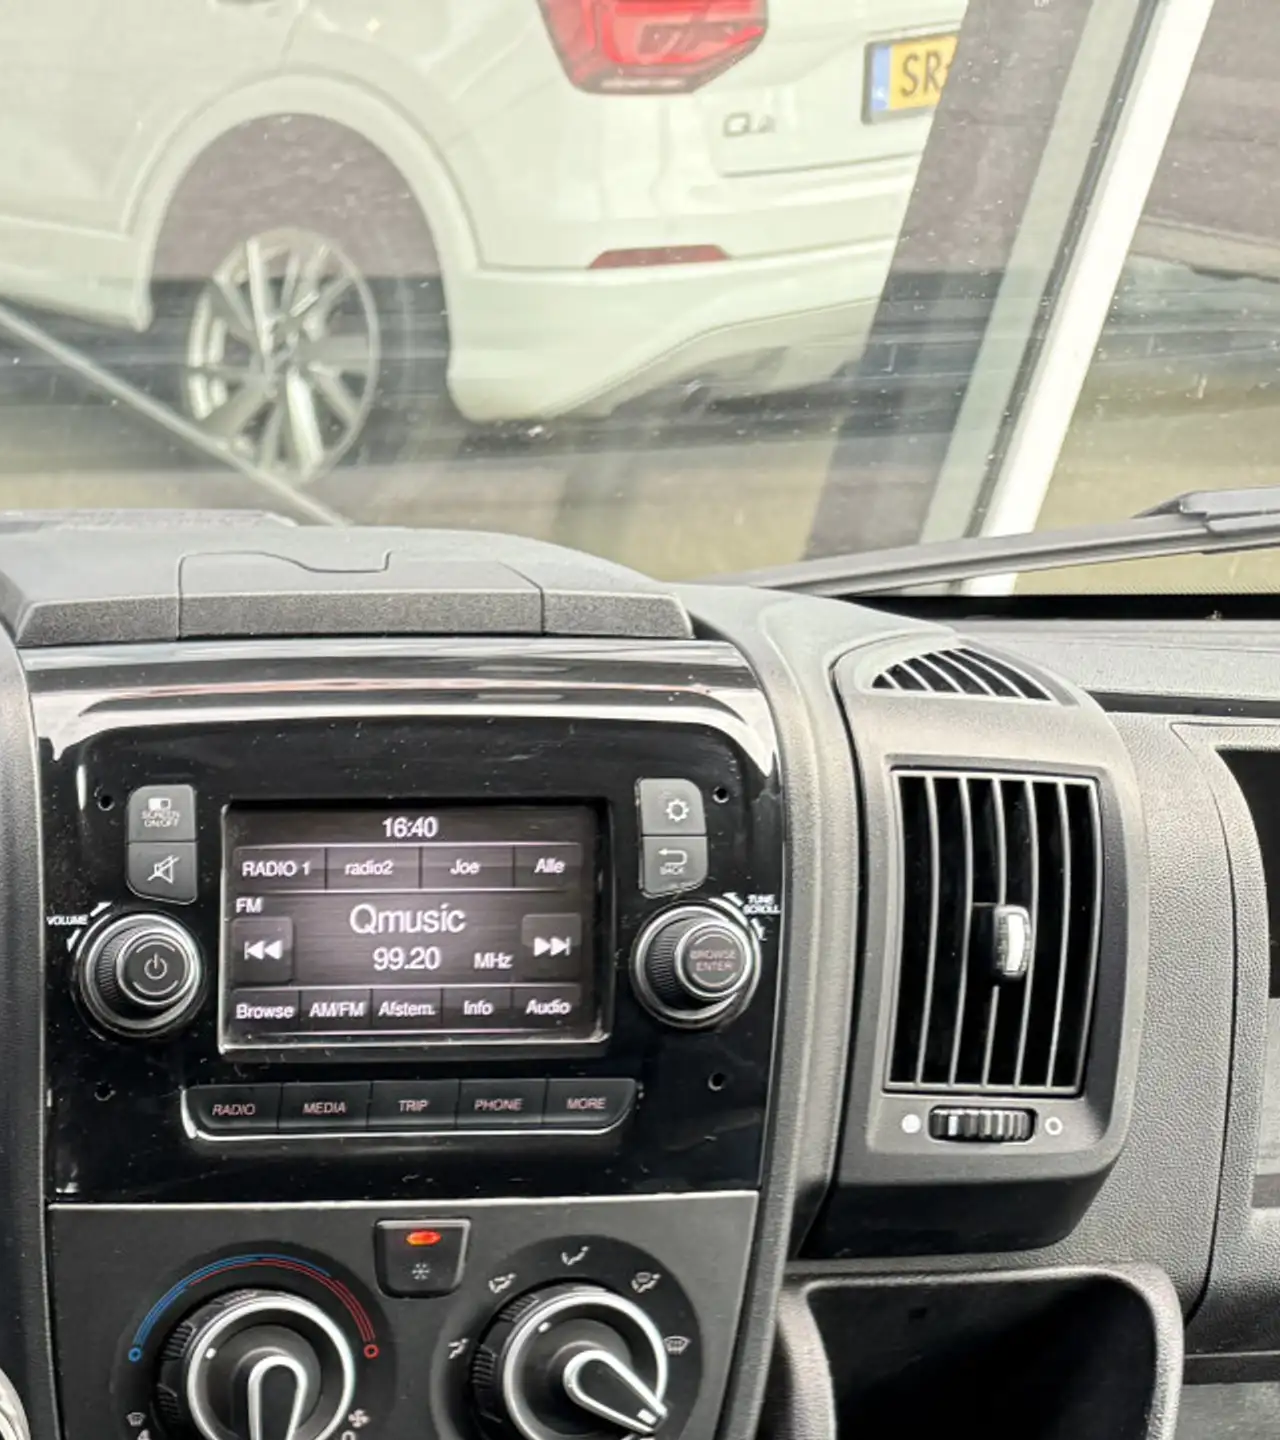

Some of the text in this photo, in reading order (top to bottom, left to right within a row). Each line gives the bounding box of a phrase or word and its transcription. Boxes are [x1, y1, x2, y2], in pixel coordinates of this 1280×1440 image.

[382, 816, 439, 838] 16:40
[242, 861, 311, 877] RADIO 1
[345, 860, 394, 876] radio2
[450, 858, 481, 875] Joe
[533, 857, 566, 875] Alle
[236, 897, 263, 914] FM
[743, 904, 781, 915] SCROLL
[46, 914, 89, 926] VOLUME
[350, 903, 467, 935] Qmusic
[372, 946, 514, 971] 99.20 MHz
[690, 950, 736, 960] BROWSE
[696, 962, 733, 972] ENTER
[235, 1004, 295, 1019] Browse
[309, 1002, 365, 1019] AM/FM
[463, 1000, 494, 1016] Info
[525, 999, 572, 1015] Audio
[212, 1103, 256, 1116] RADIO
[303, 1101, 346, 1115] MEDIA
[398, 1099, 430, 1112] TRIP
[474, 1098, 523, 1112] PHONE
[566, 1097, 607, 1110] MORE
